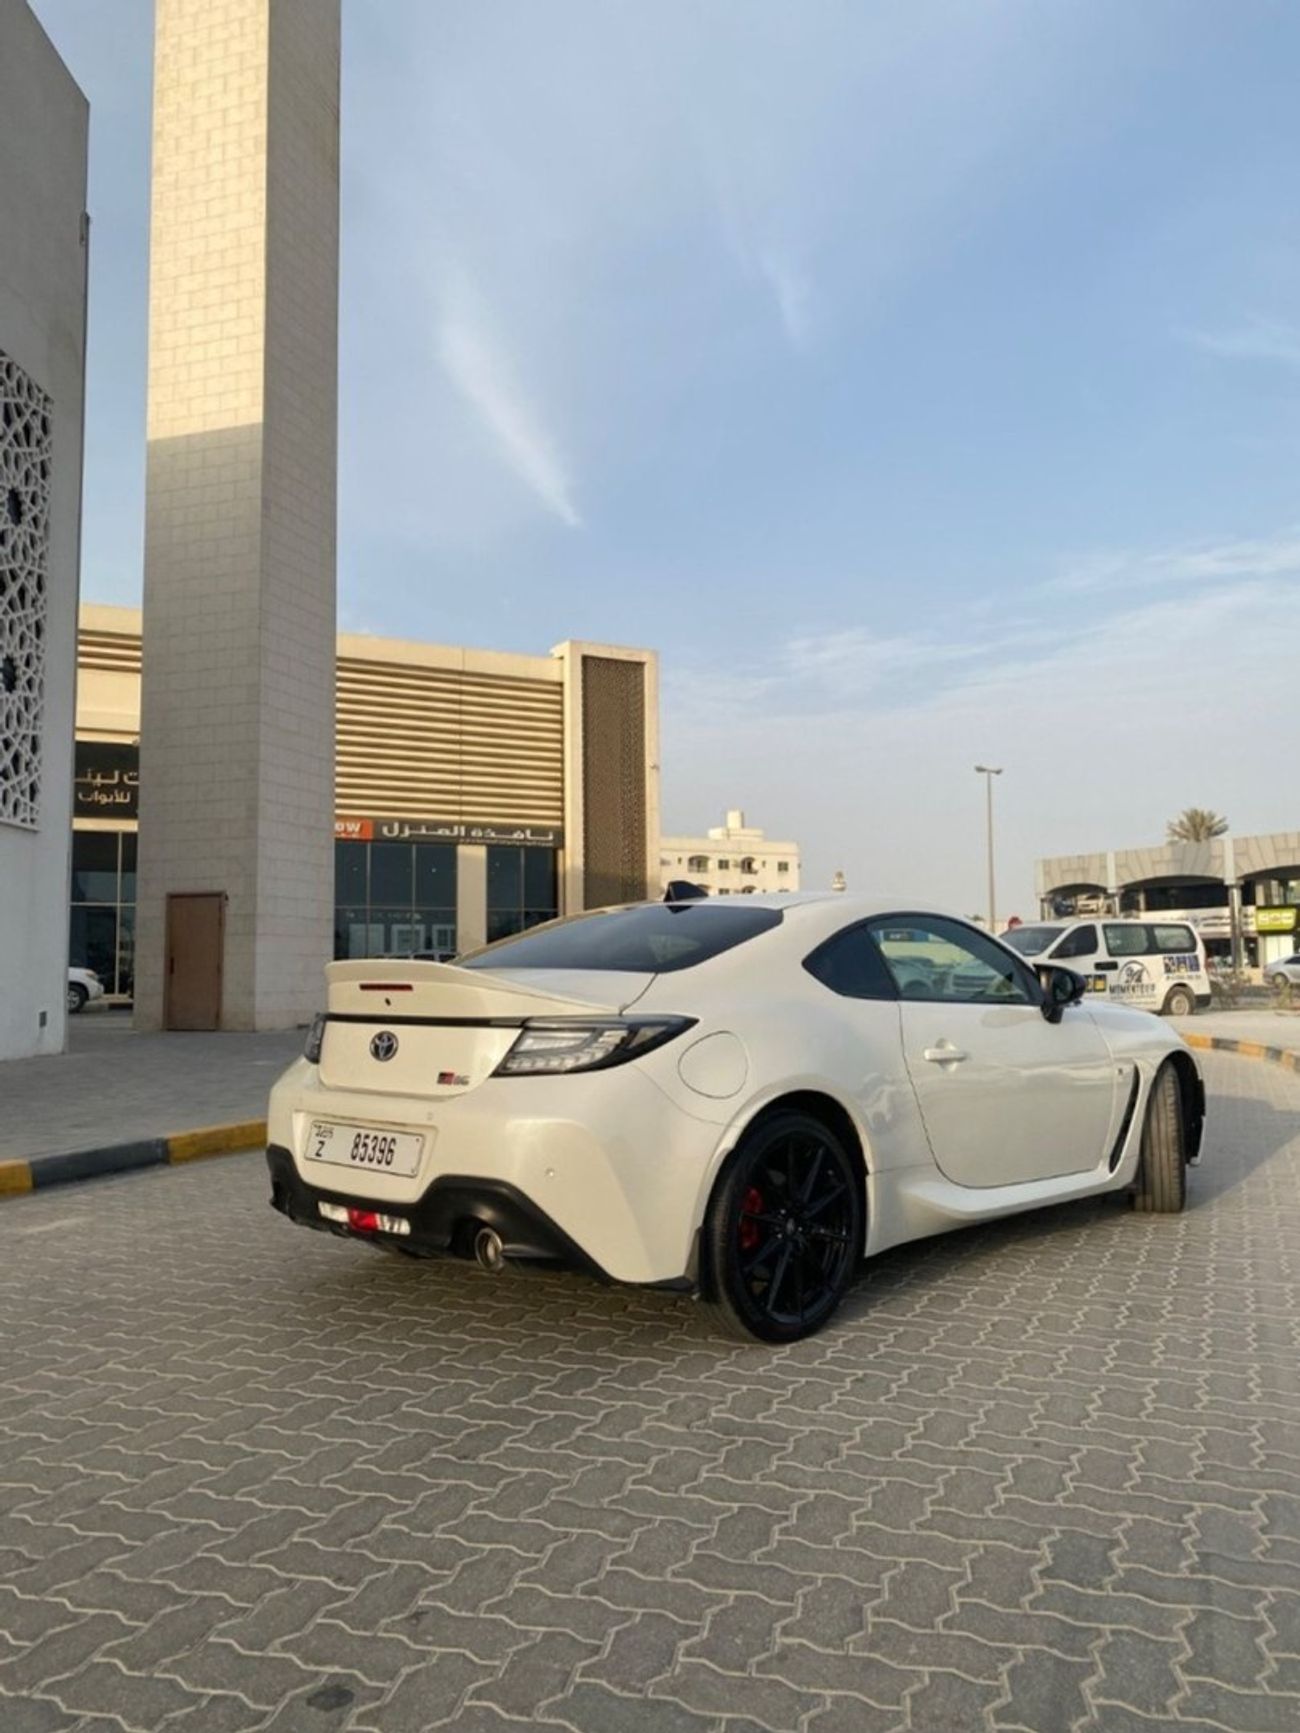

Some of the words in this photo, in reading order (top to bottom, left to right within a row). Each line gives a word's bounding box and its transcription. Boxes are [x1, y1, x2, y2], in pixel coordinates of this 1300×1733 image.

[382, 821, 466, 838] المنزل
[315, 1140, 326, 1158] Z
[350, 1132, 397, 1166] 85396
